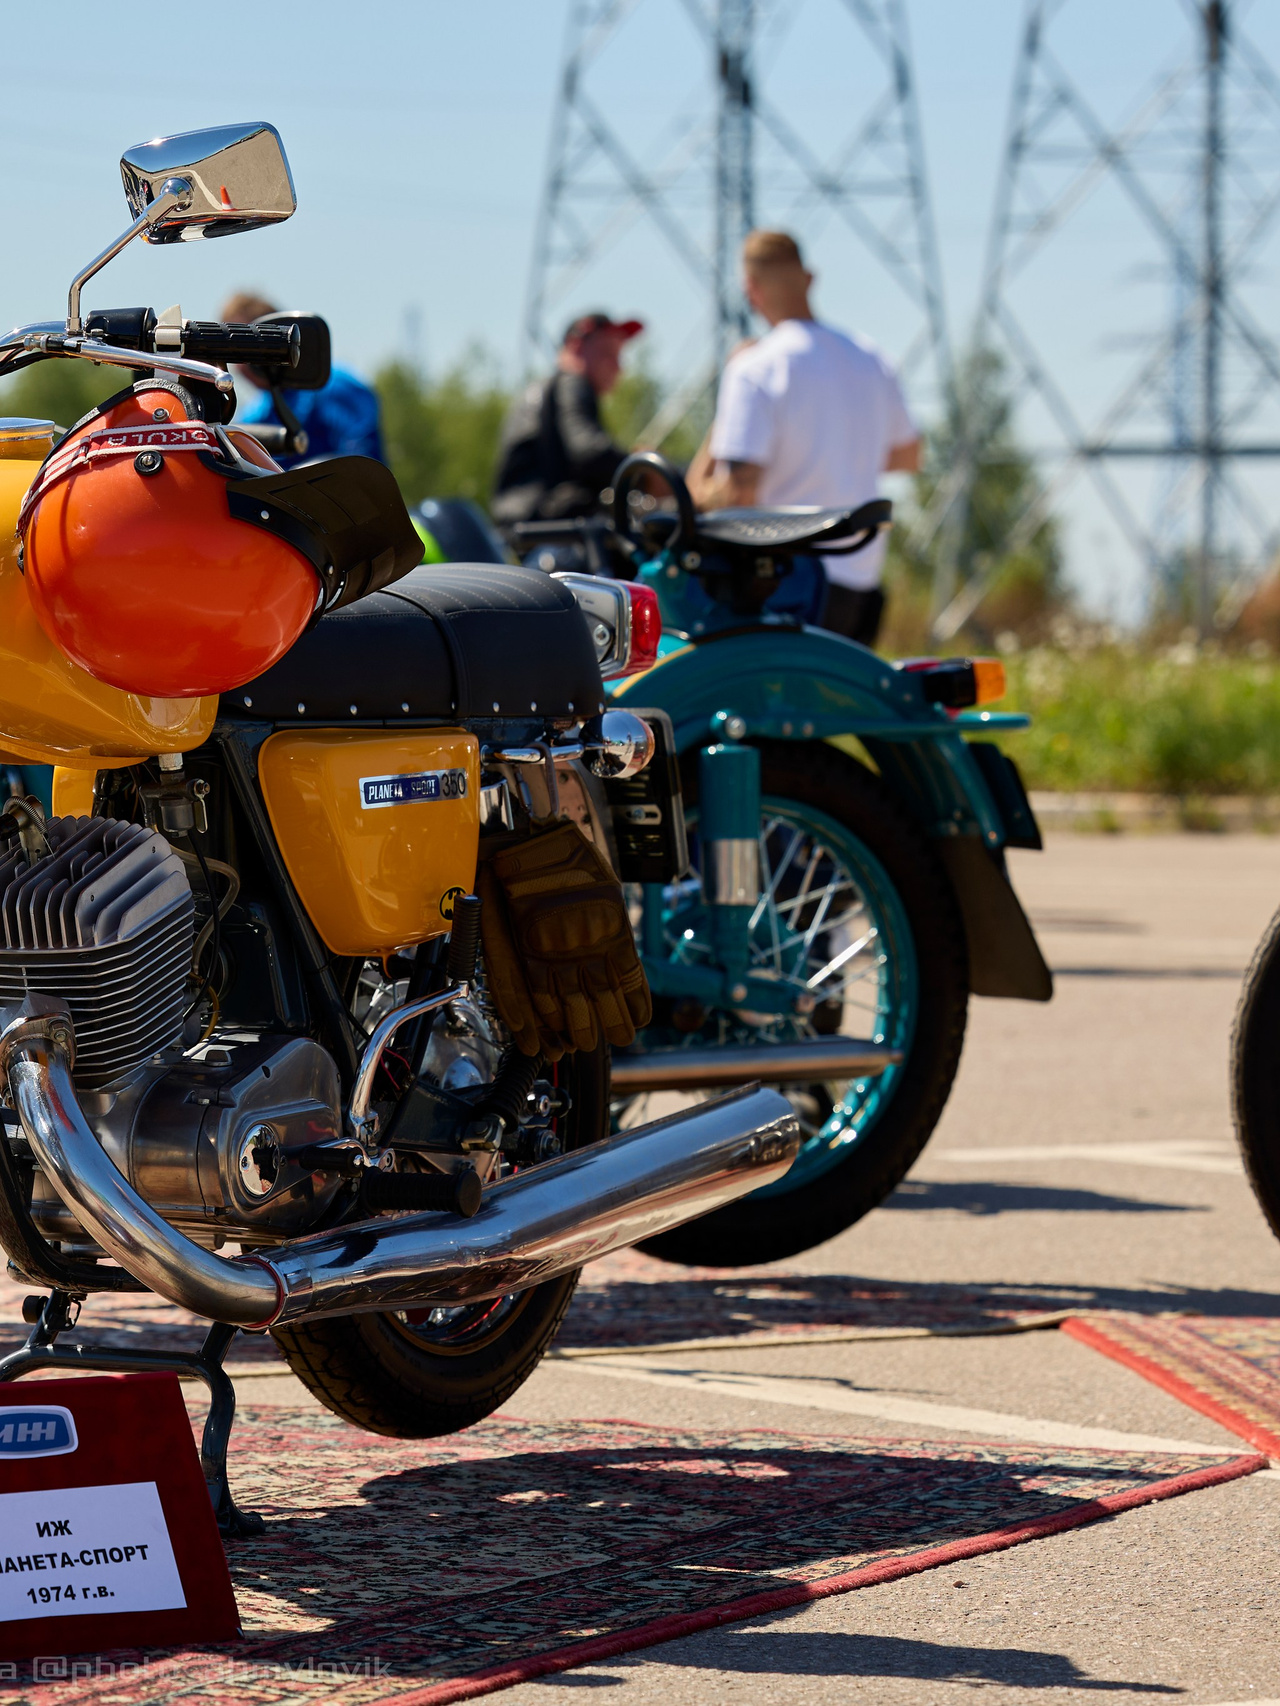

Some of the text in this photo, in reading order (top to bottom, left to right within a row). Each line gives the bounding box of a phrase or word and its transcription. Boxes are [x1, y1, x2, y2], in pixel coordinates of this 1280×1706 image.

[107, 430, 210, 446] OKULA
[368, 771, 467, 801] PLANETA SPORT 350
[35, 1519, 73, 1538] ИЖ
[26, 1584, 116, 1604] 1974 г.в.
